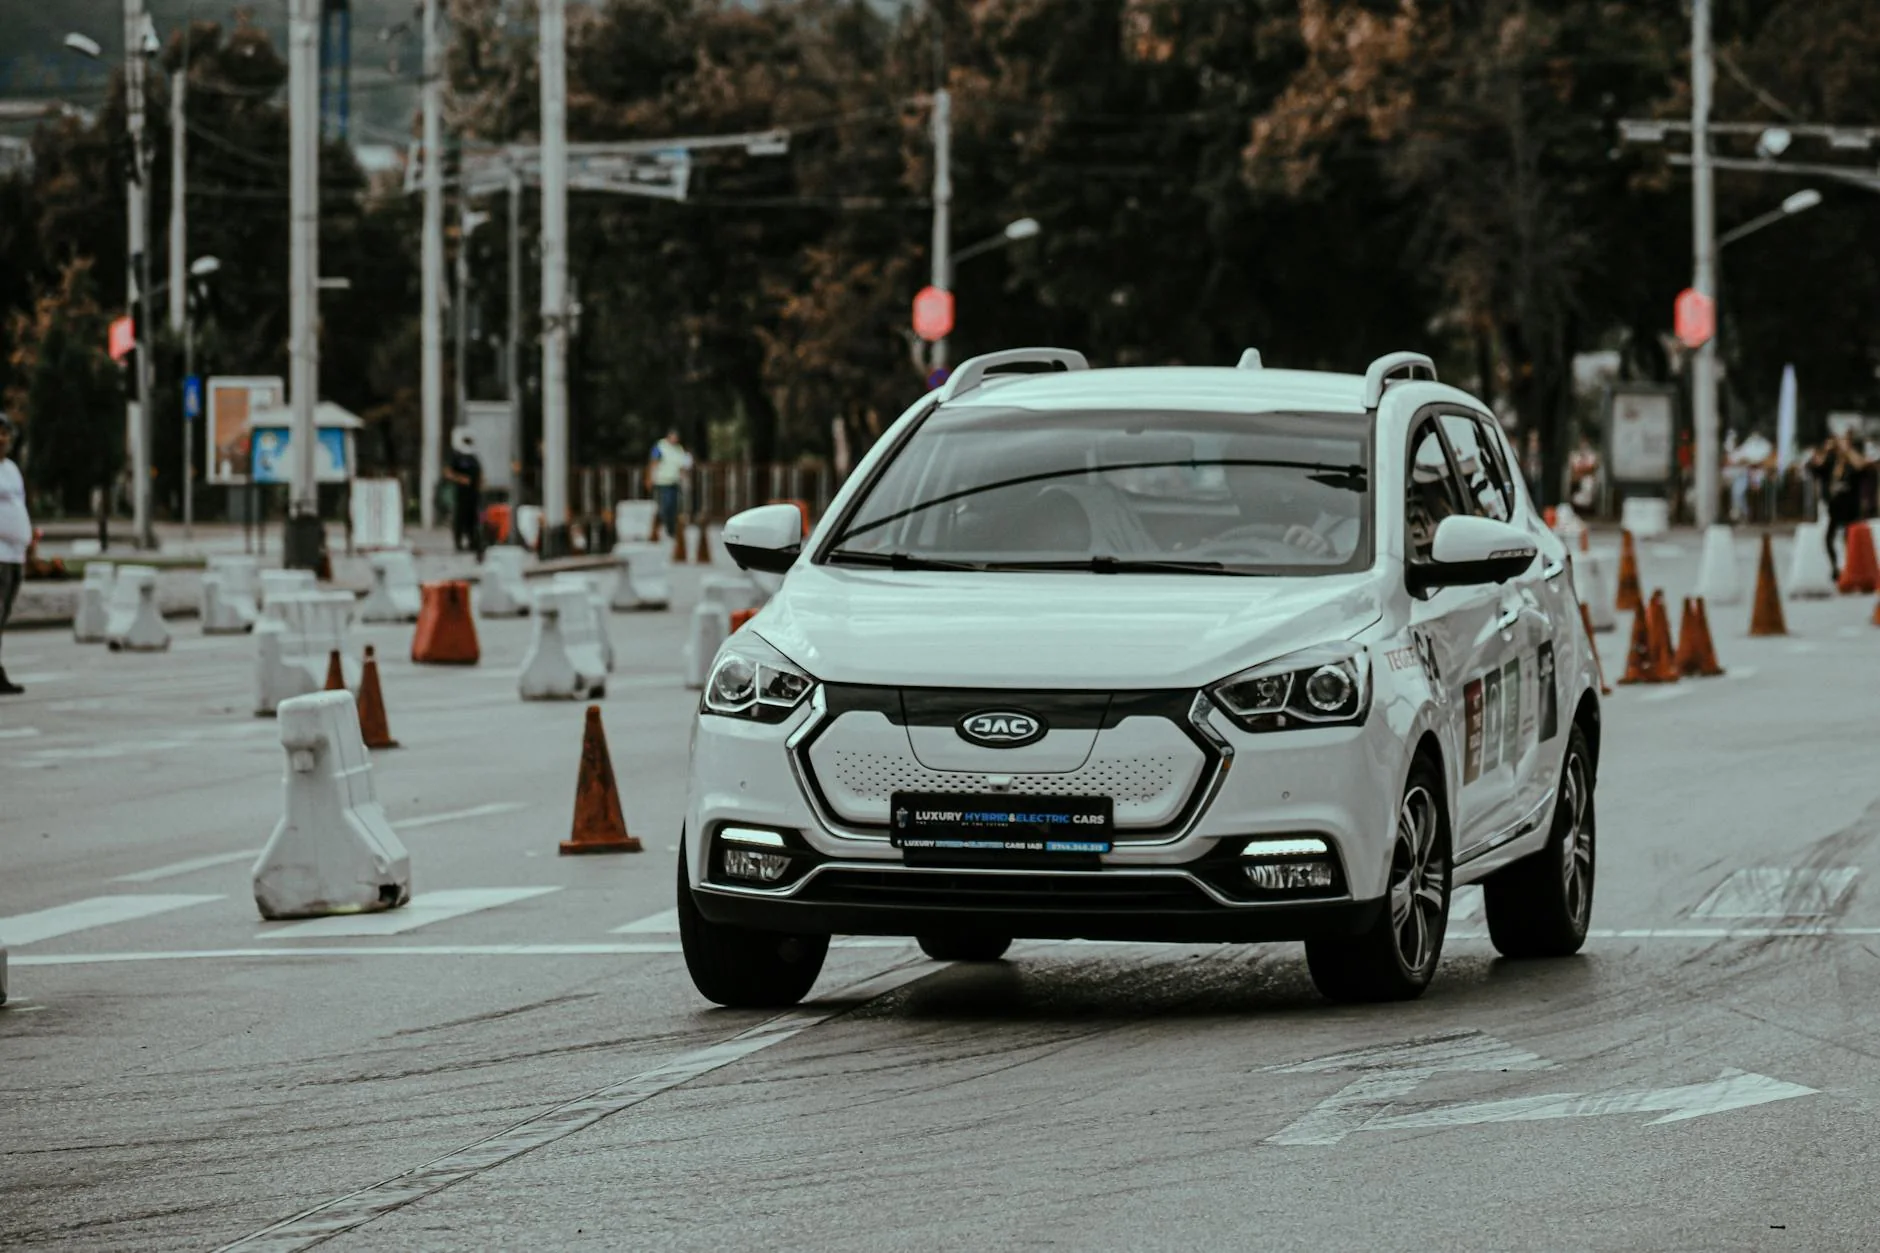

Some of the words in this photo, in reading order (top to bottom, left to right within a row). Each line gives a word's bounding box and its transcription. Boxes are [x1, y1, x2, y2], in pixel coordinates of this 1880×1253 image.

[974, 718, 1028, 734] JAC
[915, 811, 962, 821] LUXURY
[1072, 814, 1105, 824] CARS
